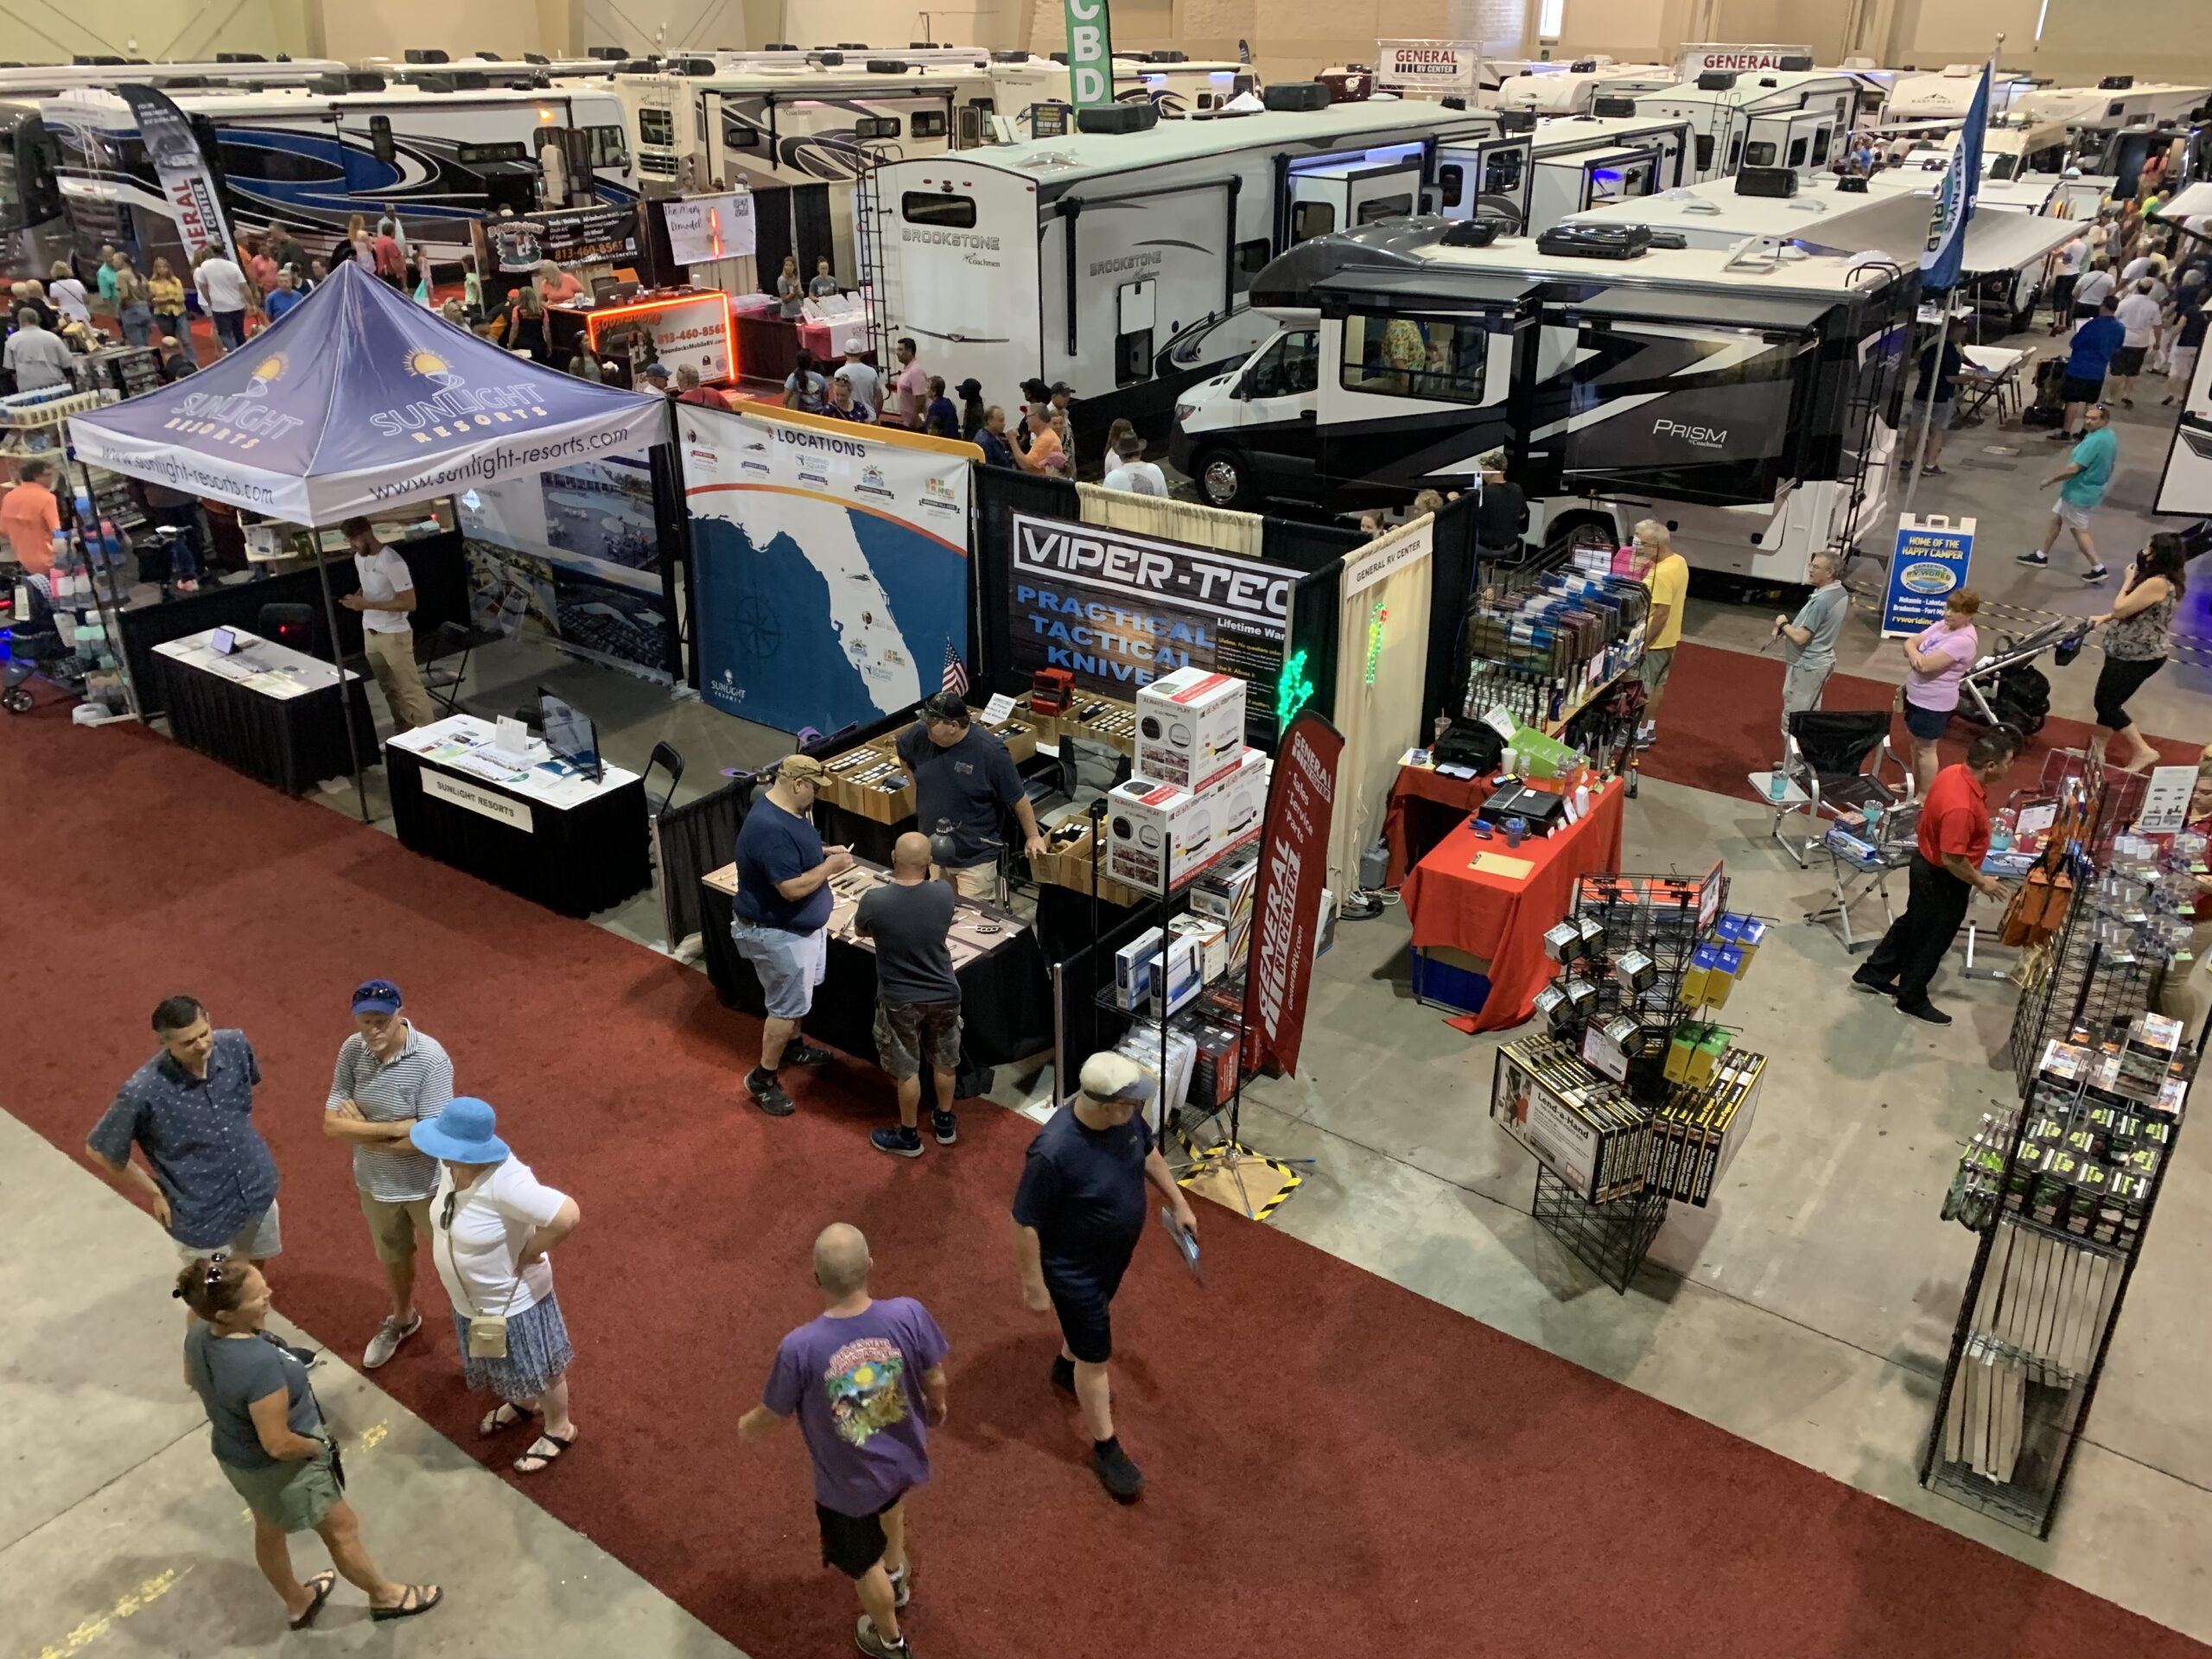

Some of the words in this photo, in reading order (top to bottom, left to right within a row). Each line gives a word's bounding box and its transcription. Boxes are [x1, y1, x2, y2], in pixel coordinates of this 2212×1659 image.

[1071, 0, 1104, 102] CBD
[1395, 49, 1458, 63] GENERAL
[1704, 54, 1781, 69] GENERAL
[1427, 65, 1453, 73] CENTER
[172, 179, 208, 250] NERAL
[555, 240, 624, 260] 813-460-8565
[902, 227, 1000, 251] BROOKSTONE
[968, 257, 1001, 268] Coachmen
[1090, 251, 1162, 277] BROOKSTONE
[657, 323, 727, 346] 813-460-8565
[170, 392, 304, 441] SUNLIGHT
[370, 383, 548, 436] SUNLIGHT
[411, 406, 549, 443] RESORTS
[164, 418, 261, 449] RESORTS
[777, 429, 866, 458] LOCATIONS
[101, 443, 274, 505] www.sunlight-resorts.com
[369, 428, 629, 500] www.sunlight-resorts.com
[1902, 547, 1929, 557] HAPPY
[1930, 549, 1964, 560] CAMPER
[1909, 537, 1931, 547] HOME
[1933, 538, 1943, 547] OF
[1945, 539, 1960, 549] THE
[1357, 560, 1385, 582] GENERAL
[1387, 553, 1396, 565] RV
[1396, 540, 1421, 560] CENTER
[1017, 585, 1216, 648] PRACTICAL
[1217, 618, 1262, 636] Lifetime
[1047, 645, 1163, 686] KNIVE
[711, 679, 747, 699] SUNLIGHT
[1294, 731, 1332, 790] GENERAL
[436, 781, 475, 804] SUNLIGHT
[478, 797, 515, 817] RESORTS
[1293, 772, 1309, 806] Sales
[1286, 810, 1304, 843] Parts
[1289, 791, 1313, 836] Service
[1279, 864, 1298, 942] CENTER
[1259, 836, 1290, 1017] GENERAL
[1274, 944, 1286, 977] RV
[1287, 925, 1303, 1011] GeneralRV.com
[1538, 1092, 1589, 1140] Lend-a-Hand
